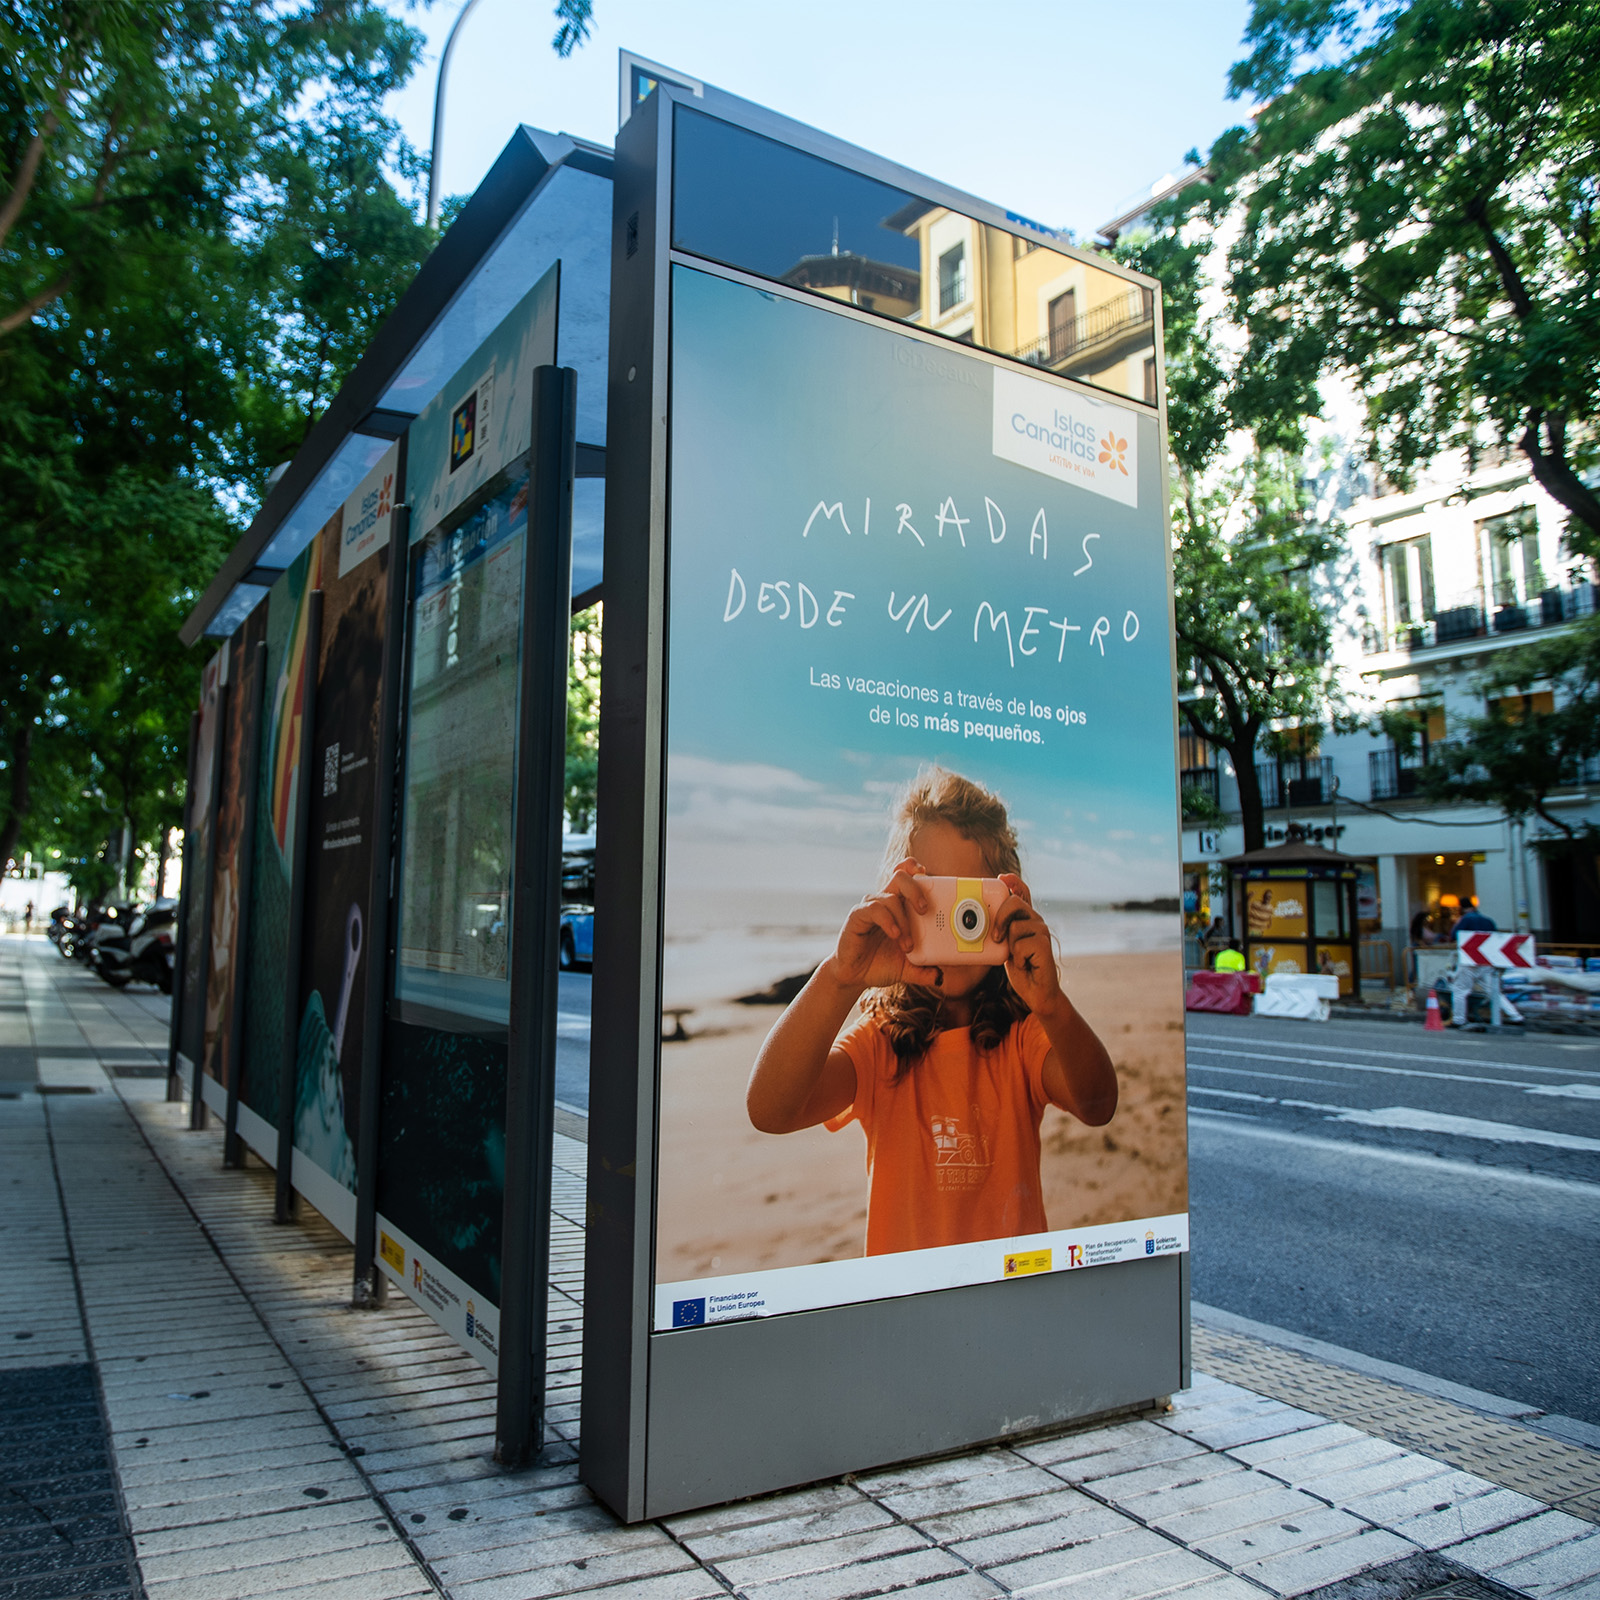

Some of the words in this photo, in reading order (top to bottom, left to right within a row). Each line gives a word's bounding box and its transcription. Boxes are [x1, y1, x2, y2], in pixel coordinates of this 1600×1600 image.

[1011, 413, 1096, 462] Canarias
[1054, 408, 1096, 443] Islas
[803, 496, 1101, 577] MIRADAS
[723, 568, 855, 629] DESDE
[888, 591, 952, 633] UN
[974, 601, 1140, 668] METRO
[810, 667, 841, 690] Las
[846, 676, 939, 703] vacaciones
[943, 691, 953, 705] a
[957, 689, 1003, 713] través
[1007, 697, 1026, 716] de
[1030, 700, 1051, 720] los
[1056, 708, 1087, 726] ojos
[869, 705, 891, 725] de
[896, 707, 919, 728] los
[924, 712, 959, 733] más
[964, 720, 1045, 745] pequeños.
[1085, 1246, 1122, 1257] Transformación
[1156, 1236, 1177, 1244] Gobierno
[1162, 1242, 1182, 1250] Canarias
[1090, 1255, 1116, 1263] Resiliencia
[709, 1293, 745, 1303] Financiado
[747, 1290, 759, 1300] por
[717, 1303, 737, 1312] Unión
[738, 1299, 765, 1309] Europea
